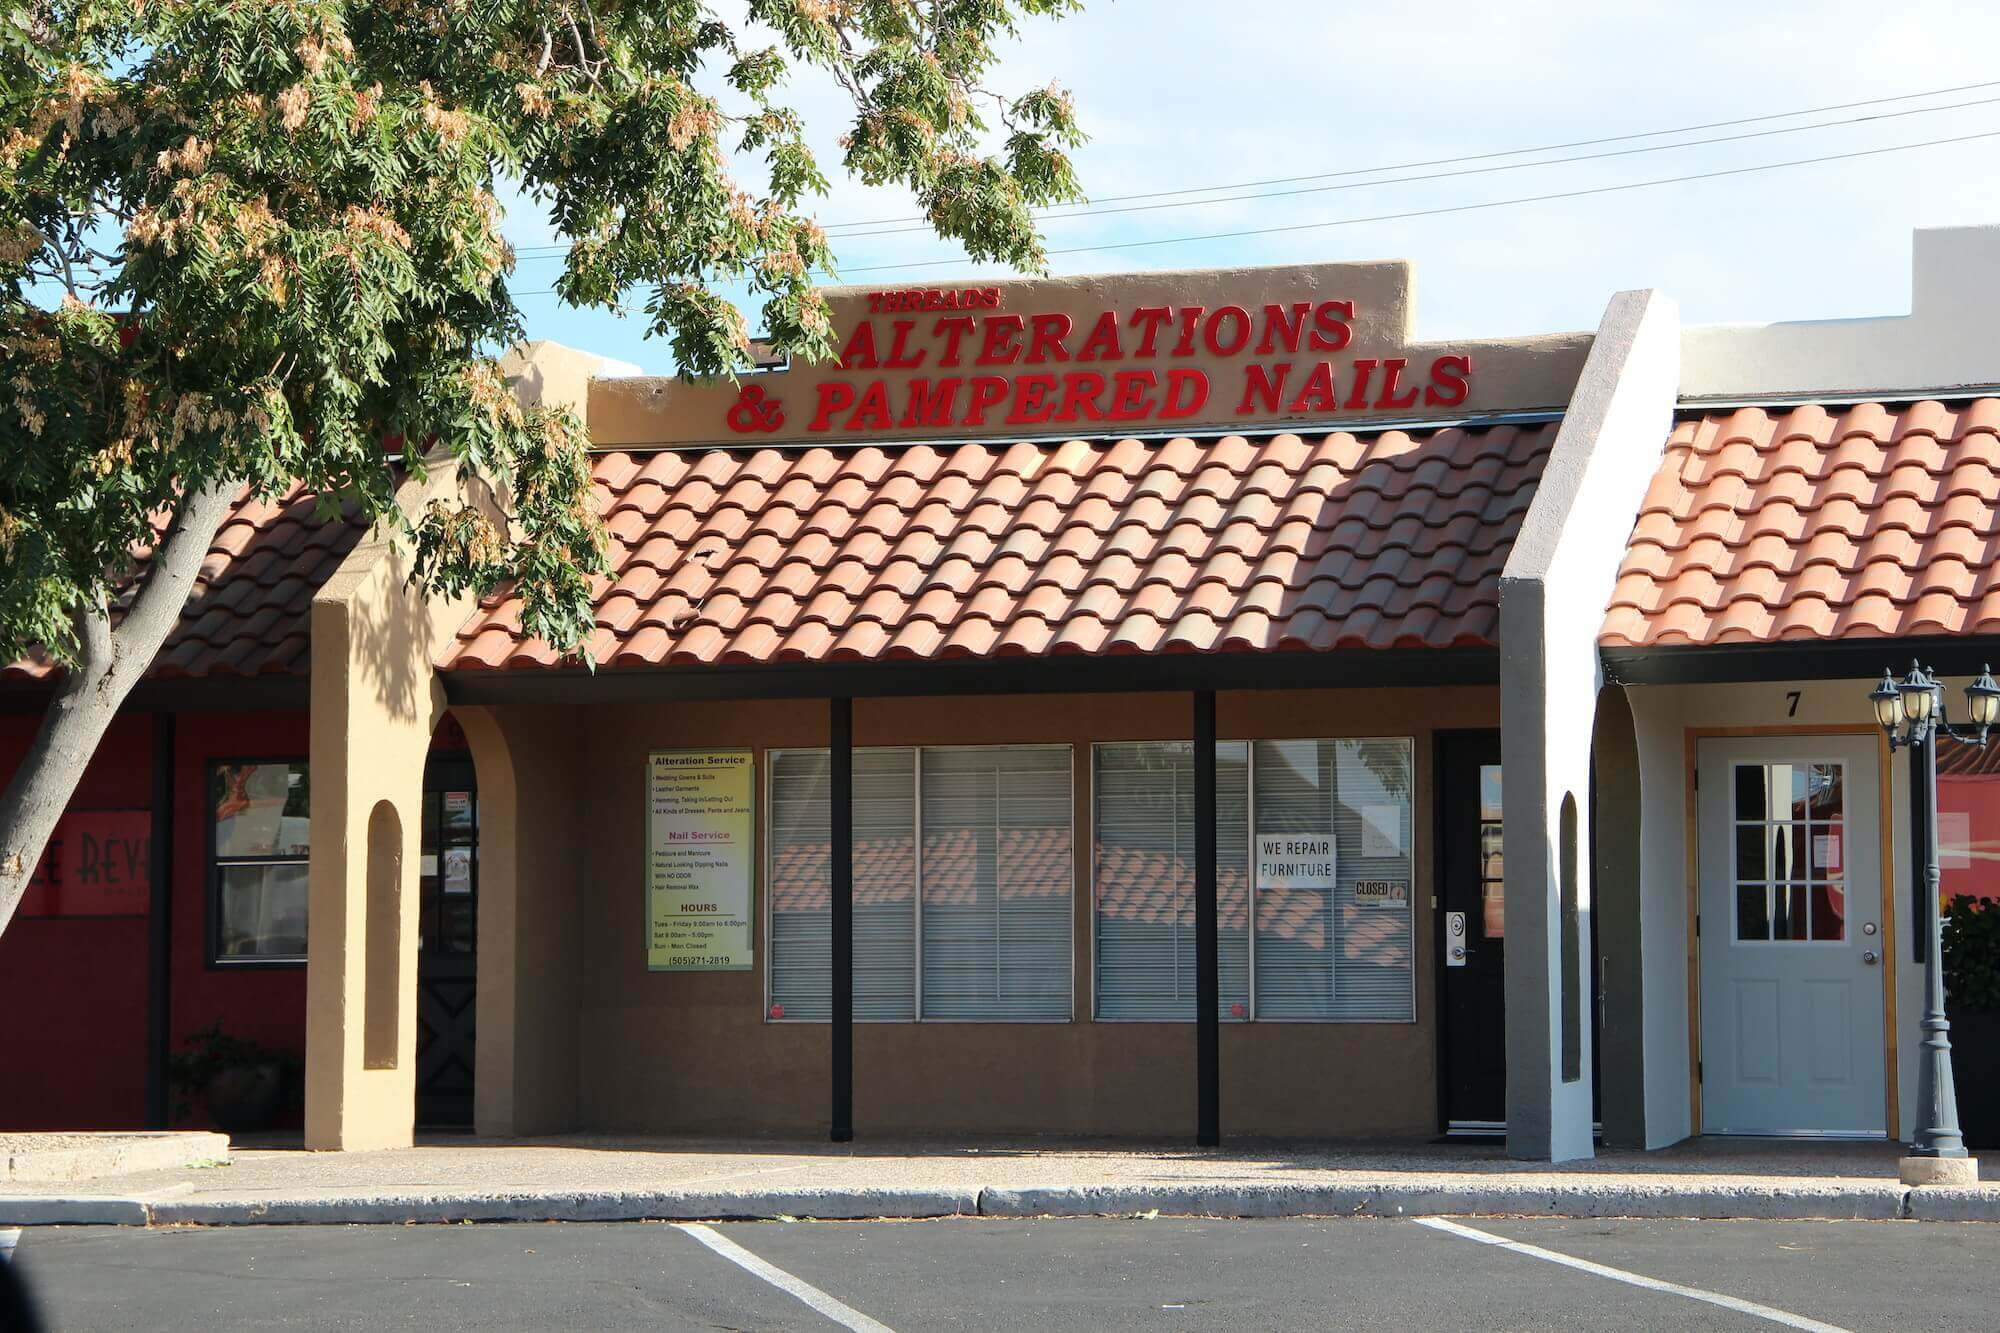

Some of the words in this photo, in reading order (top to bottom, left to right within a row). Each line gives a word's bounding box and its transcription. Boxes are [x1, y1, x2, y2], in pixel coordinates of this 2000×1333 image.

[867, 287, 1001, 313] THREADS
[832, 301, 1356, 370] ALTERATIONS
[726, 384, 785, 434] &
[807, 364, 1210, 432] PAMPERED
[1235, 355, 1474, 415] NAILS
[1786, 691, 1801, 717] 7
[655, 757, 704, 765] Alteration
[707, 756, 746, 765] Service
[669, 831, 688, 840] Nail
[691, 831, 730, 840] Service
[1263, 841, 1281, 855] WE
[1286, 840, 1330, 855] REPAIR
[1261, 863, 1332, 877] FURNITURE
[1356, 882, 1388, 895] CLOSED
[680, 903, 718, 912] HOURS
